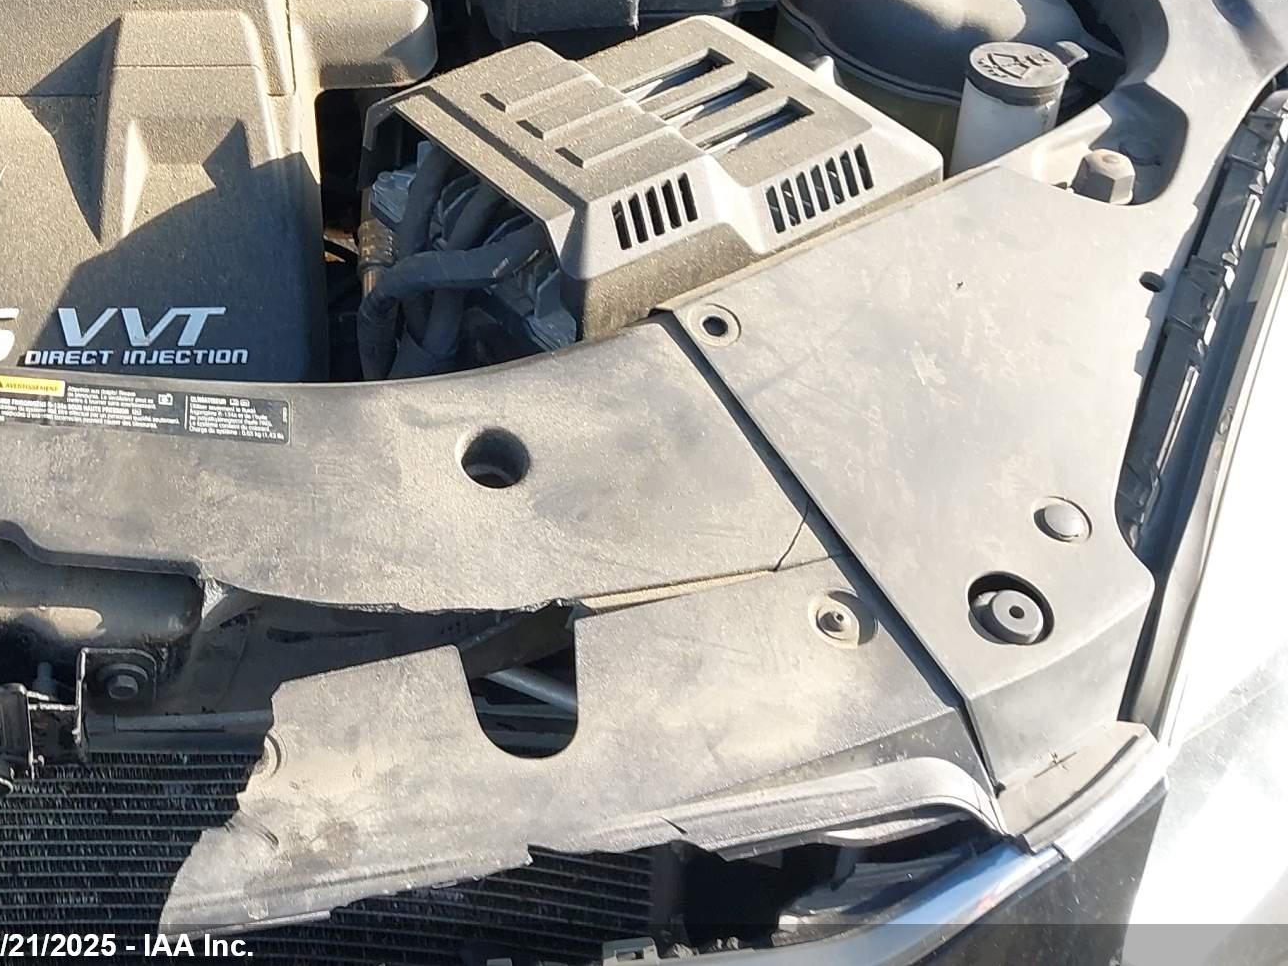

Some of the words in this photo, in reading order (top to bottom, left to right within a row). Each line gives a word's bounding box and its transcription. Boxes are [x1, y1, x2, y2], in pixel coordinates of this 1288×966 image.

[58, 306, 227, 347] VVT
[24, 348, 115, 365] DIRECT
[121, 348, 248, 366] INJECTION
